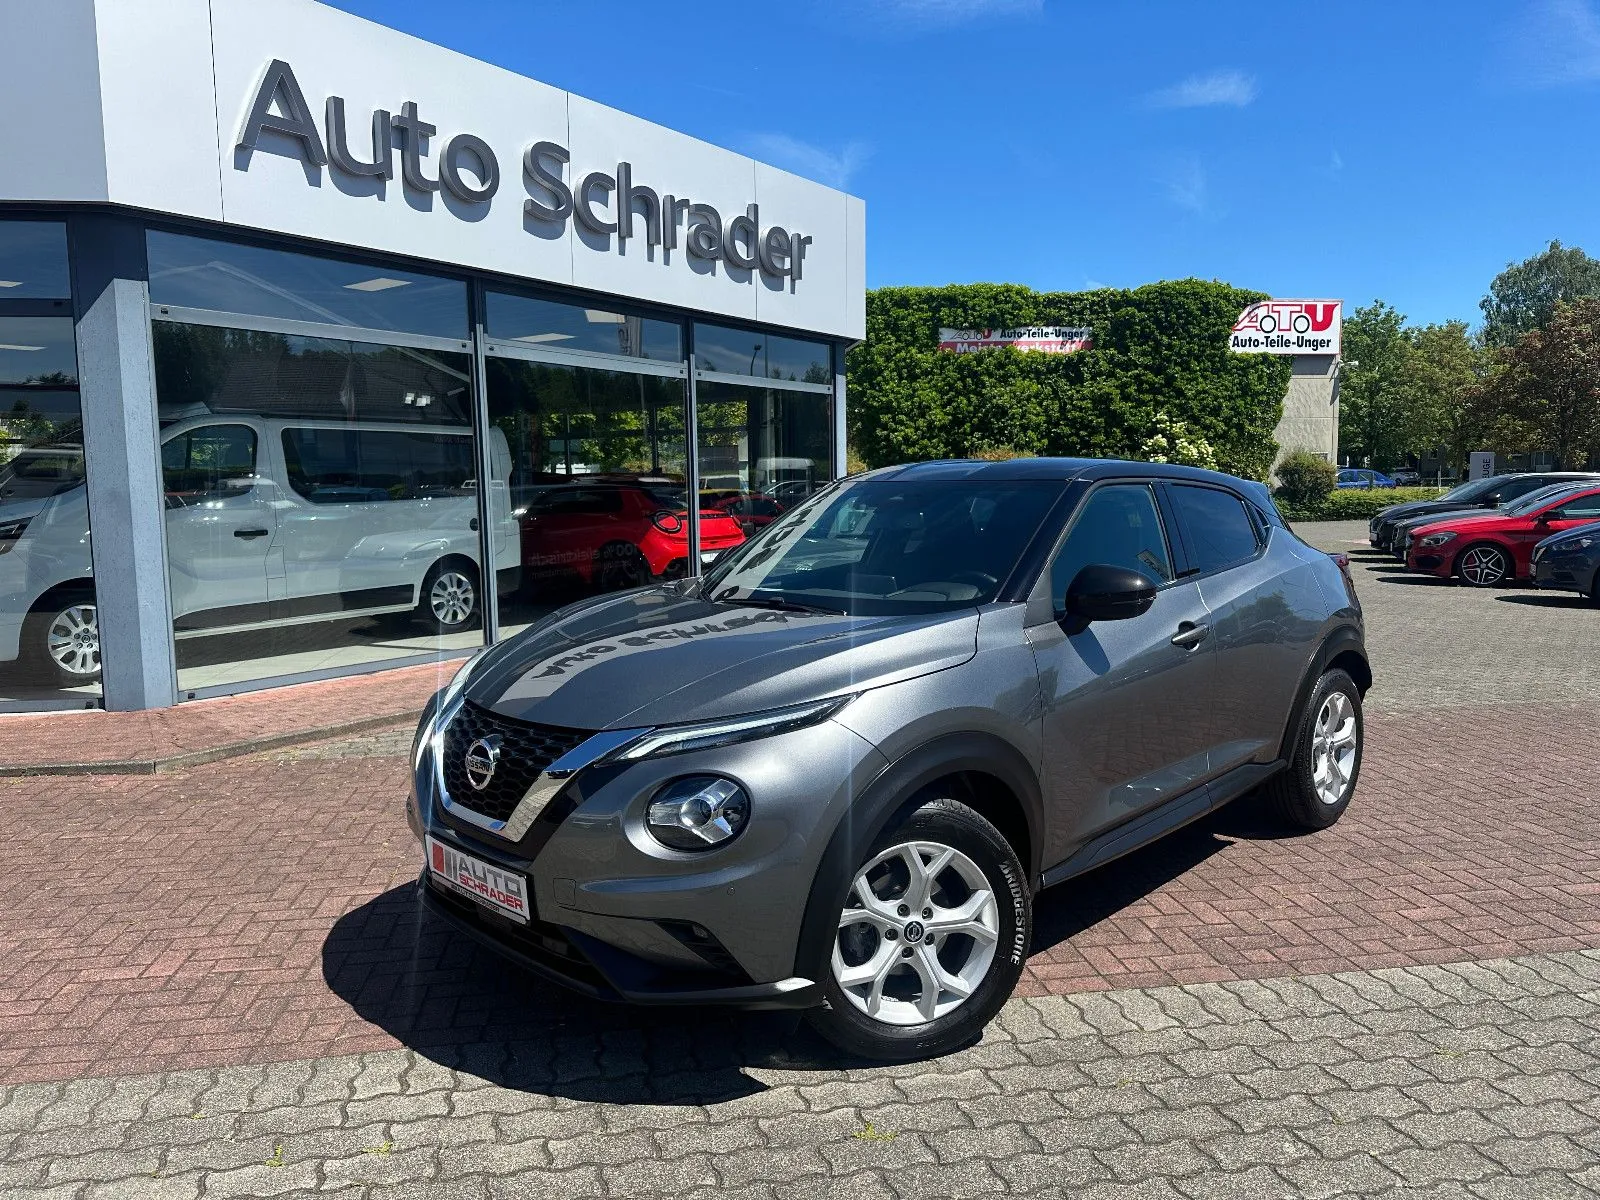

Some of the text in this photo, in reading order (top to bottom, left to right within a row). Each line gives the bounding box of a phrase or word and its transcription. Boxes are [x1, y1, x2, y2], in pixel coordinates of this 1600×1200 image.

[236, 58, 813, 281] Auto Schrader
[1000, 328, 1084, 340] Auto-Teile-Unger
[1232, 335, 1331, 351] Auto-Teile-Unger
[458, 855, 522, 896] AUTO
[459, 873, 524, 912] SCHRADER
